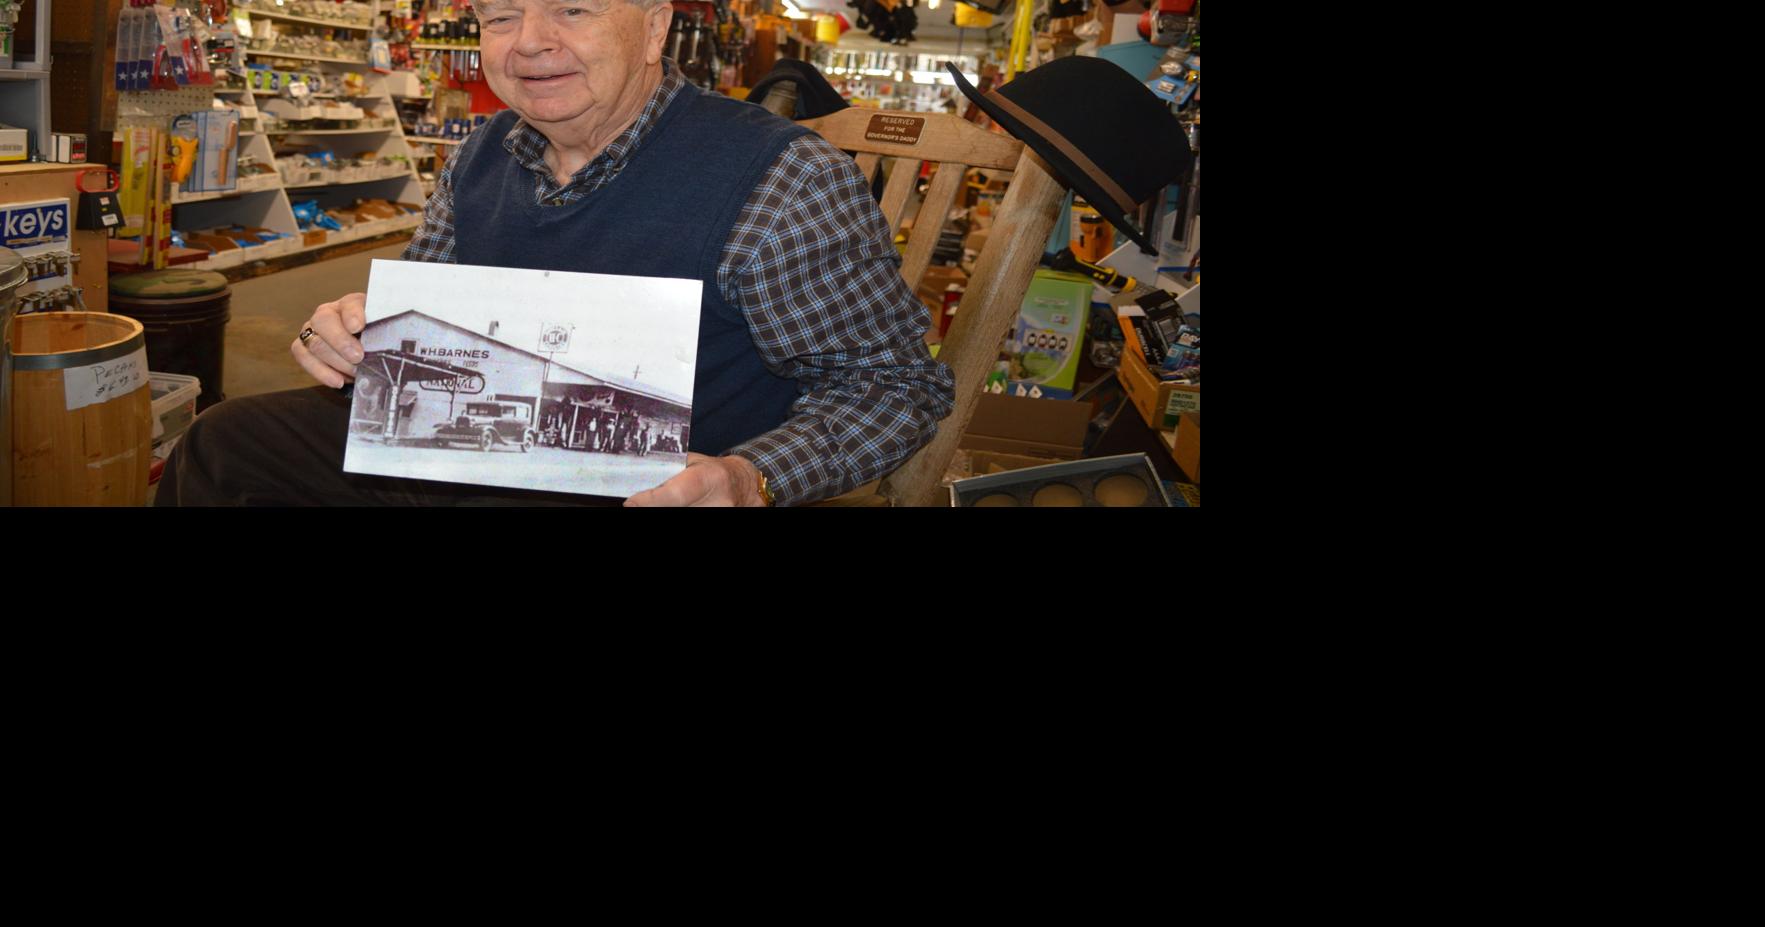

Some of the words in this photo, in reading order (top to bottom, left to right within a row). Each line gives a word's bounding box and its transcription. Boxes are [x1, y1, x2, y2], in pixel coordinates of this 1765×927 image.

[880, 116, 915, 126] RESERVED
[866, 132, 899, 141] GOVERNOR'S
[900, 135, 917, 143] DADDY
[3, 207, 64, 240] keys
